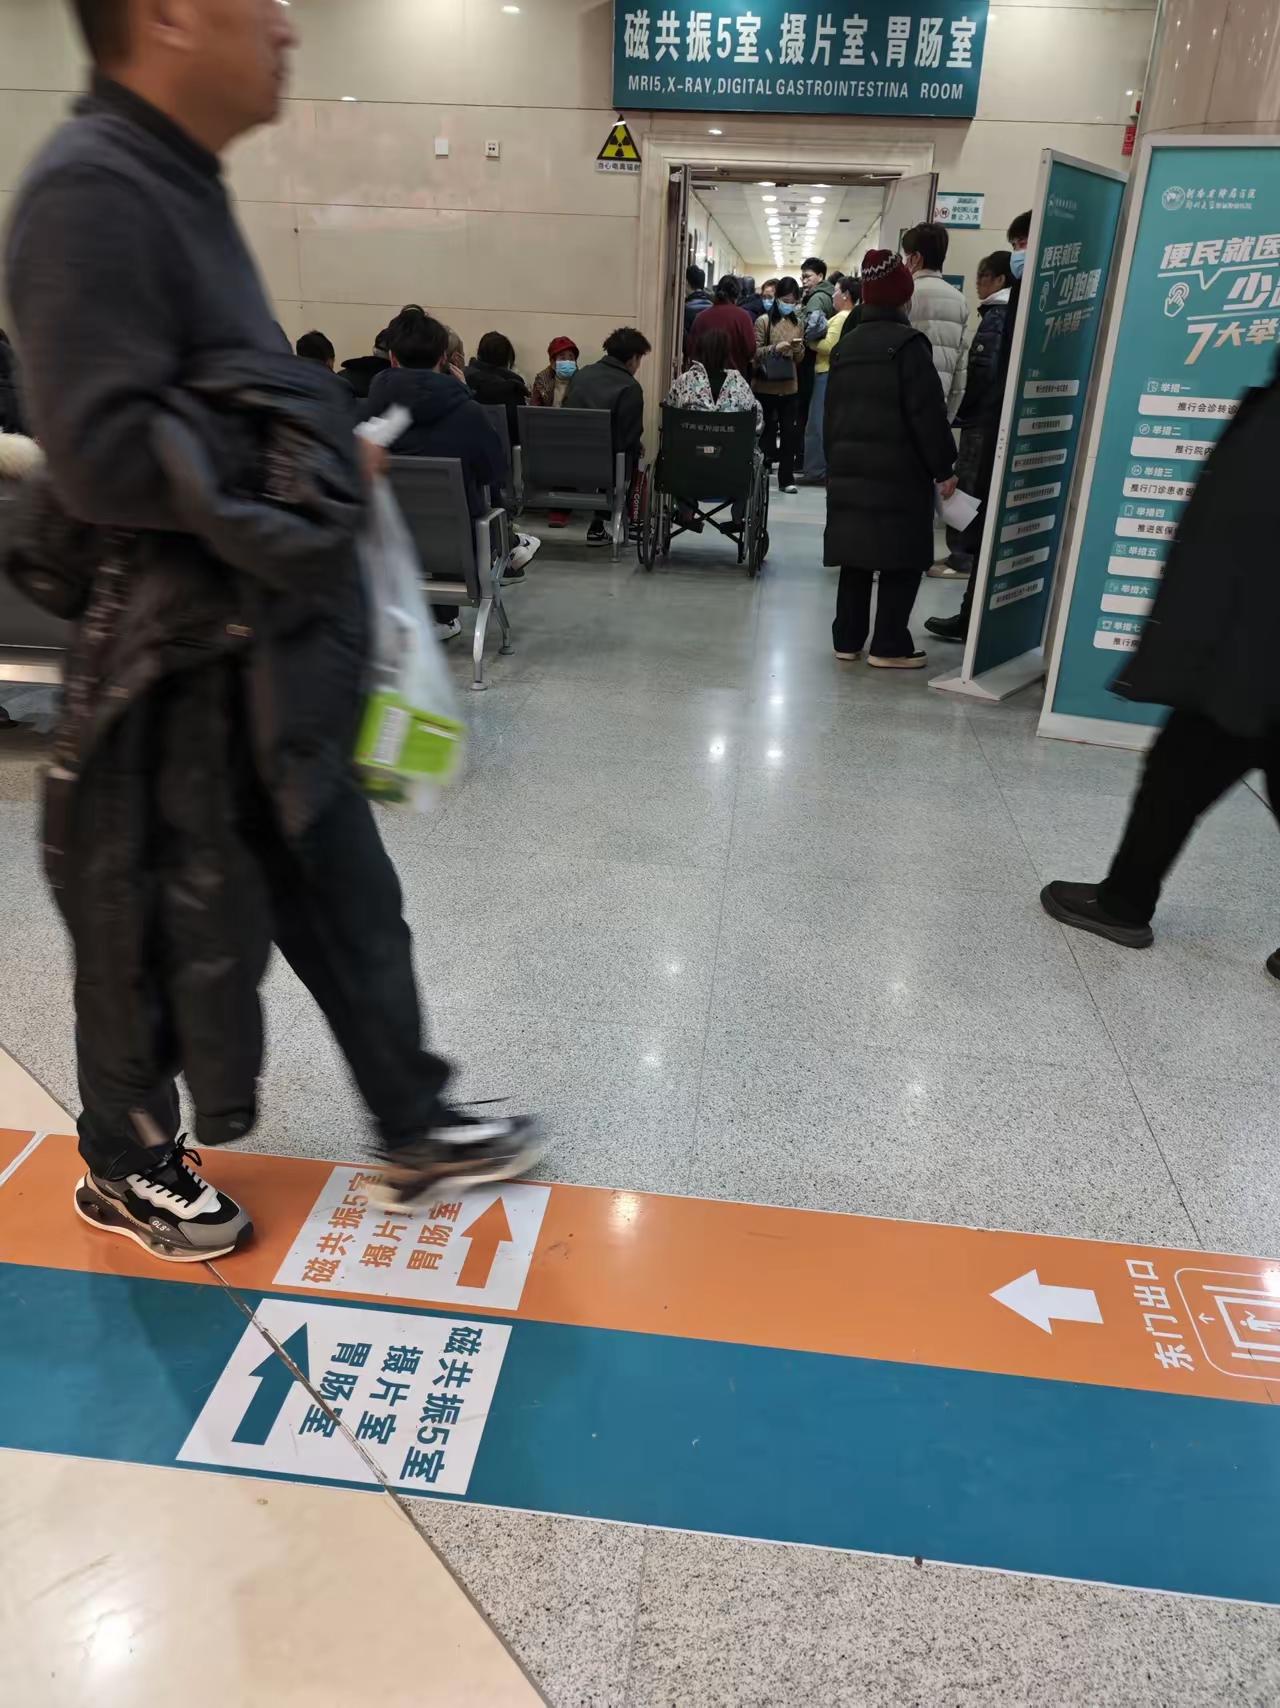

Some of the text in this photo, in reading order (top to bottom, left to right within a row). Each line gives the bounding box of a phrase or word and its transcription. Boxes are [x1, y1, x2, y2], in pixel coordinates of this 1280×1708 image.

[624, 9, 977, 69] 磁共振5室、摄片室、胃肠室
[776, 78, 909, 98] GASTROINTESTINA
[920, 83, 964, 100] ROOM
[1159, 234, 1280, 269] 便民就医
[1222, 272, 1280, 311] 少
[1184, 318, 1280, 365] 7大举
[359, 1210, 413, 1268] 摄片
[406, 1199, 462, 1270] 胃肠室
[1125, 1259, 1195, 1371] 东门出口
[298, 1342, 372, 1438] 胃肠室
[355, 1345, 423, 1445] 摄片室
[399, 1326, 483, 1483] 磁共振5室
